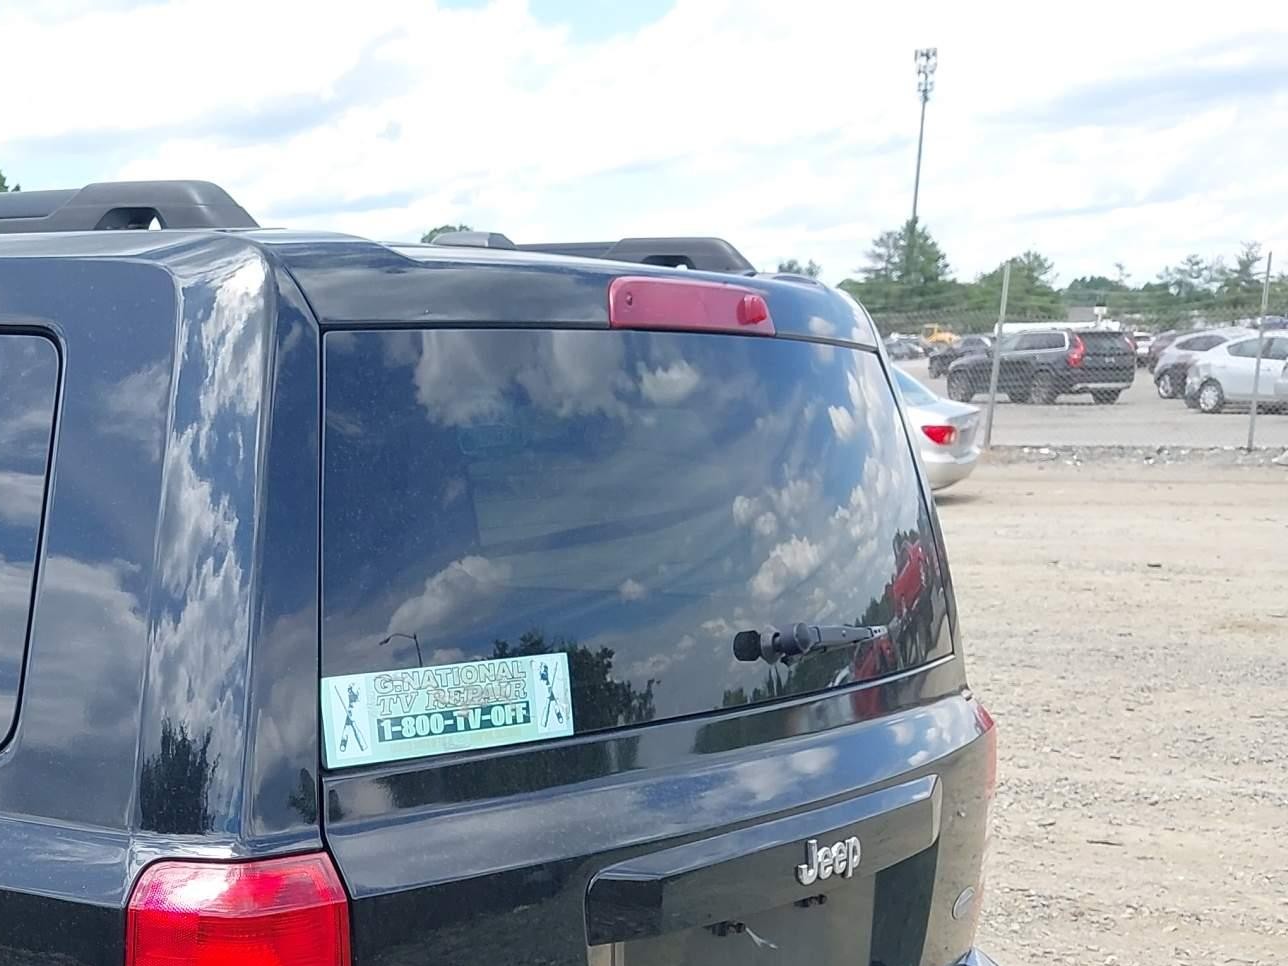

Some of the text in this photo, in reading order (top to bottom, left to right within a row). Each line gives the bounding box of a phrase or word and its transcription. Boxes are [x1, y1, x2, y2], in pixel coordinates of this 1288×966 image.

[375, 679, 528, 716] TV REPAIR
[380, 701, 528, 741] 1-800-TV-OFF
[797, 836, 862, 886] Jeep
